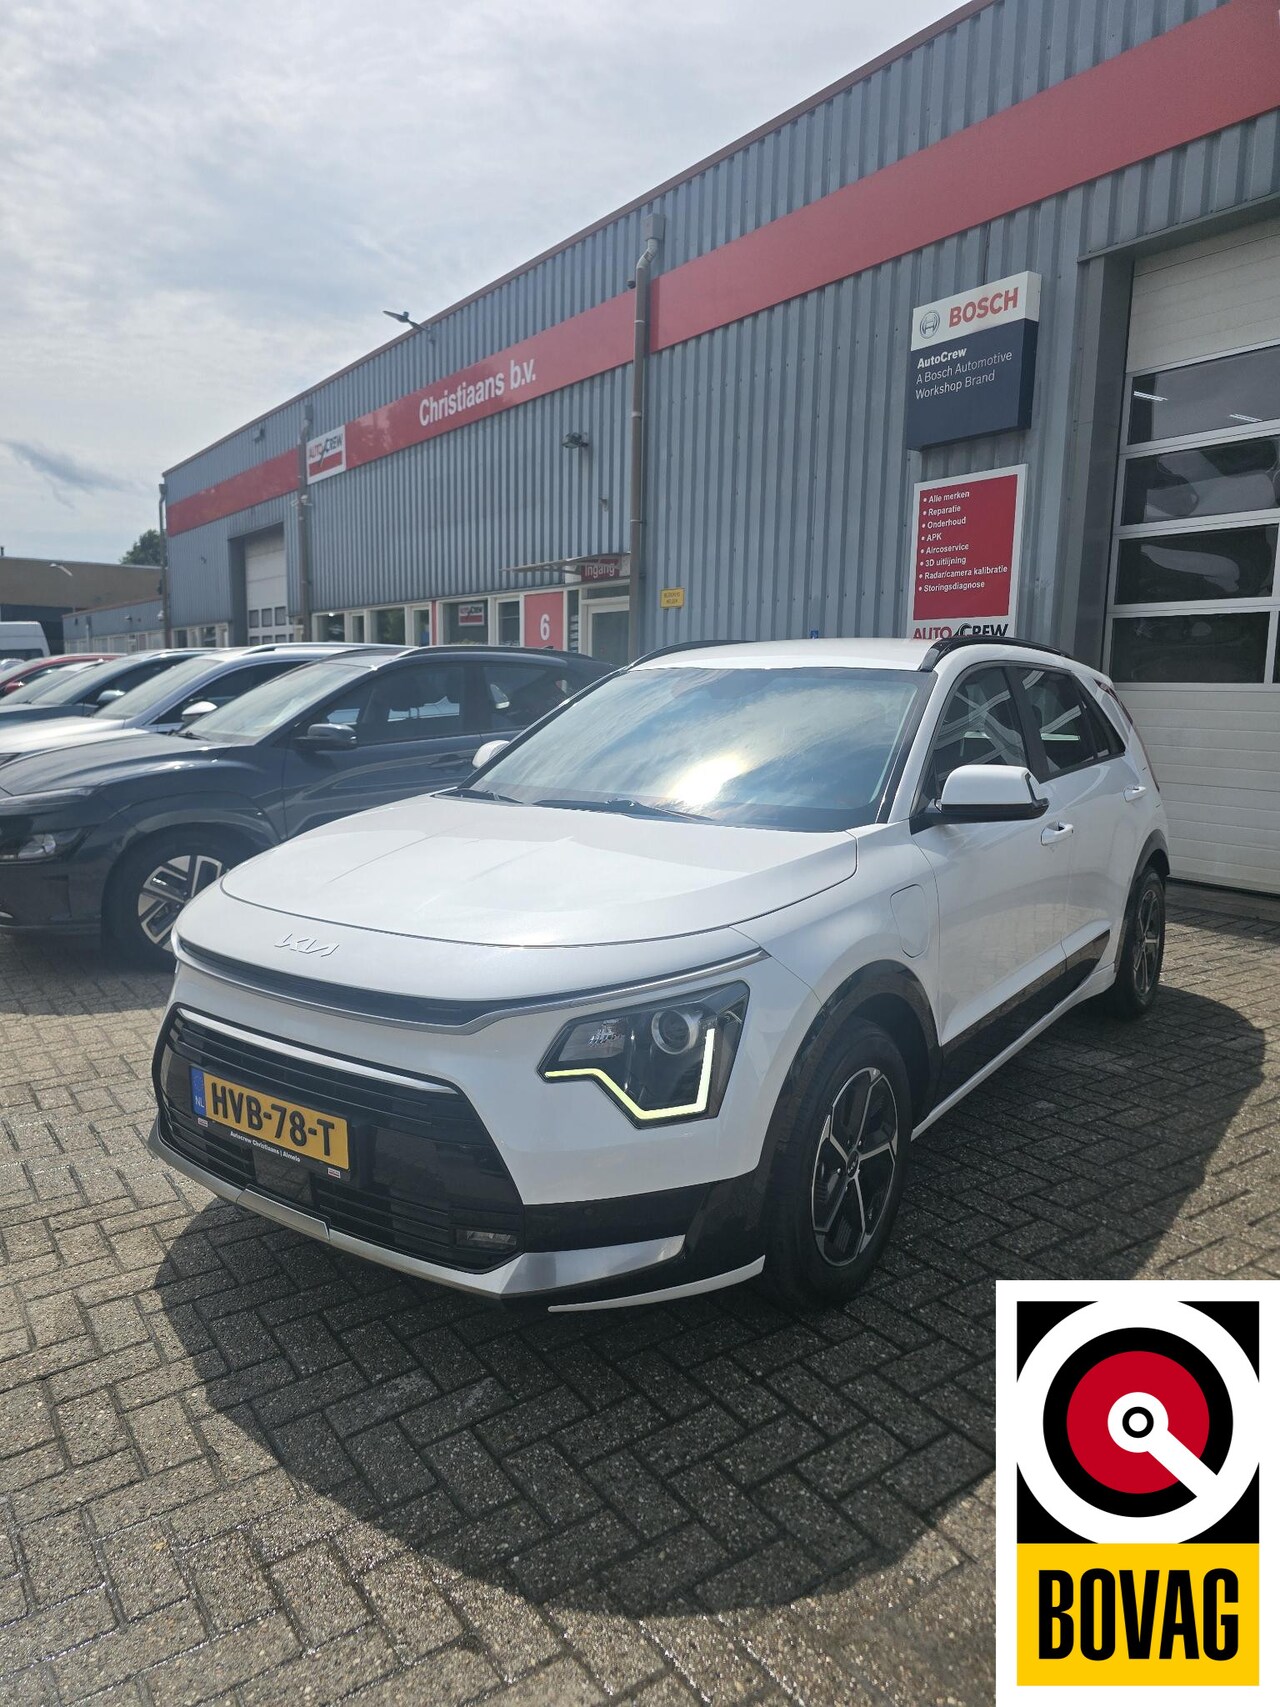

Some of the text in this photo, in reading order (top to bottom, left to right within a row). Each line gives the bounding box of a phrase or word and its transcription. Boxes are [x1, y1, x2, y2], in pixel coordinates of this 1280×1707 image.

[949, 287, 1019, 328] BOSCH
[917, 348, 967, 369] AutoCrew
[916, 351, 1012, 385] A Bosch Automotive
[419, 359, 536, 426] Christiaans b.v.
[915, 370, 996, 400] Workshop Brand
[929, 491, 970, 503] Alle merken
[928, 505, 961, 517] Reparatie
[927, 517, 966, 529] Onderhoud
[926, 533, 942, 542] APK
[925, 543, 969, 555] Aircoservice
[925, 556, 966, 567] 3D uitlijning
[584, 563, 615, 578] Ingang
[924, 565, 1008, 580] Radar/camera kalibratie
[923, 581, 985, 593] Storingsdiagnose
[540, 613, 550, 641] 6
[273, 933, 340, 958] KIA
[195, 1096, 205, 1108] NL
[211, 1082, 335, 1157] HVB-78-T
